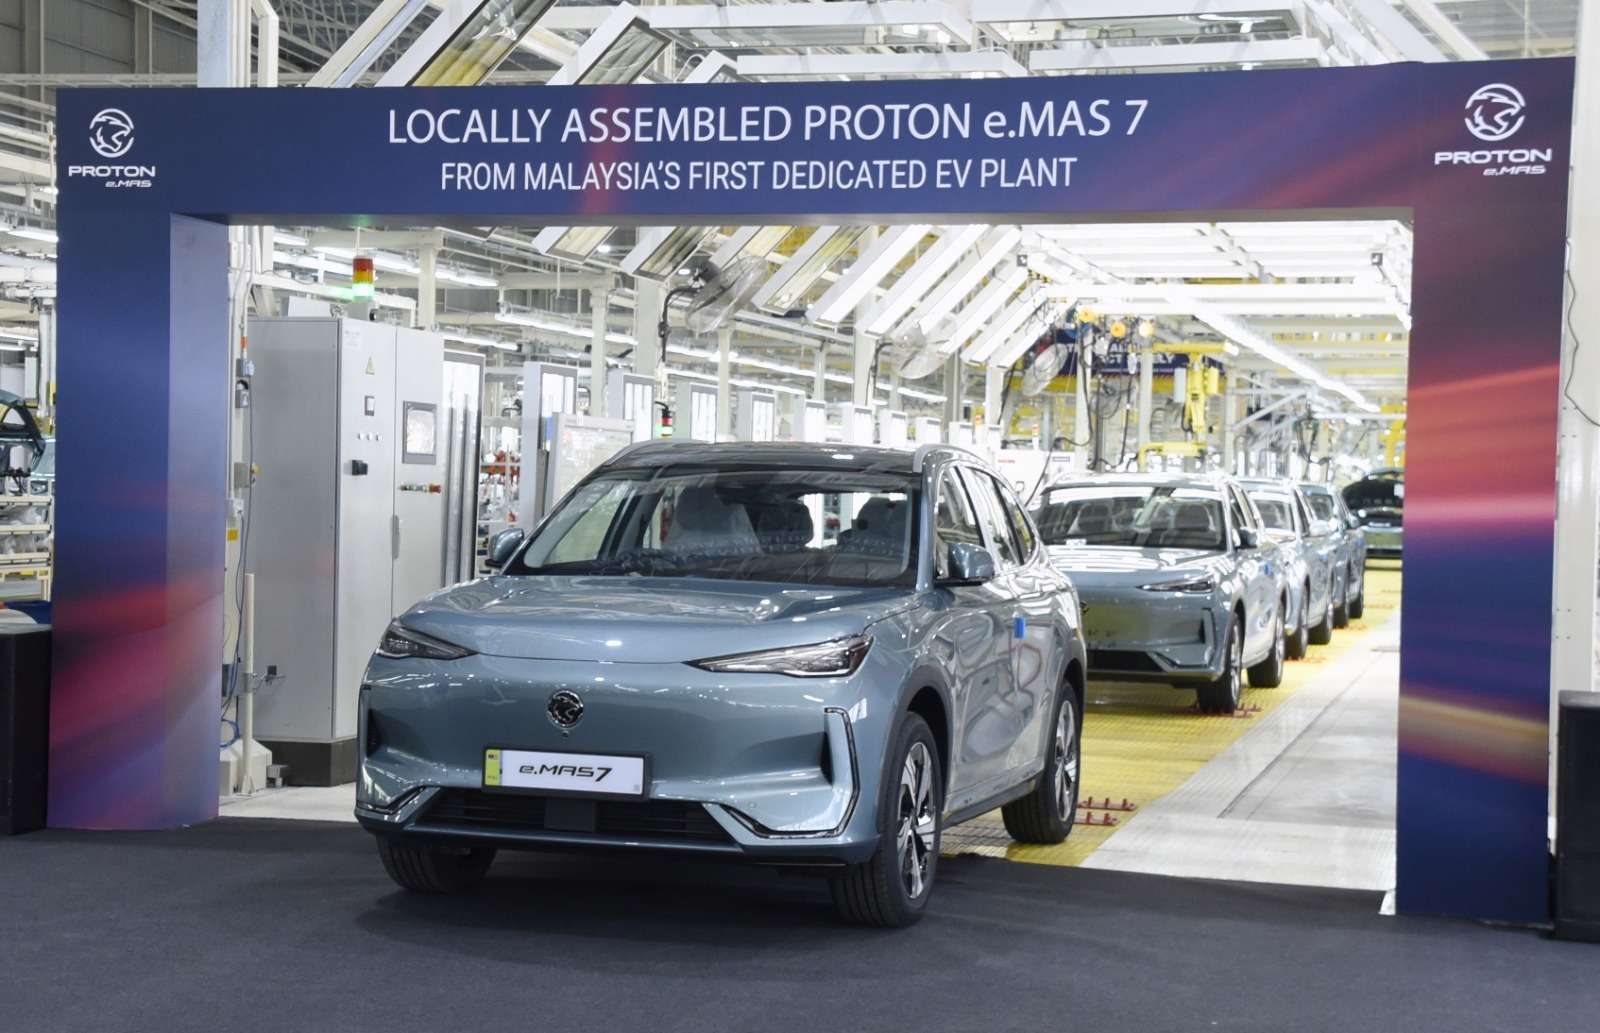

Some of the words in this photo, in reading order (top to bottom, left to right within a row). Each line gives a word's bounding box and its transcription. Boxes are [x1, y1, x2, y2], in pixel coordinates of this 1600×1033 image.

[389, 108, 552, 144] LOCALLY
[560, 105, 792, 143] ASSEMBLED
[804, 102, 971, 141] PROTON
[983, 98, 1111, 139] e.MAS
[1125, 99, 1149, 136] 7
[1434, 148, 1552, 165] PROTON
[68, 165, 156, 178] PROTON
[441, 162, 515, 191] FROM
[524, 160, 681, 191] MALAYSIA’S
[689, 160, 765, 190] FIRST
[772, 159, 927, 190] DEDICATED
[936, 158, 973, 189] EV
[980, 157, 1078, 188] PLANT
[1482, 165, 1547, 176] e.MAS
[105, 179, 152, 188] e.MAS
